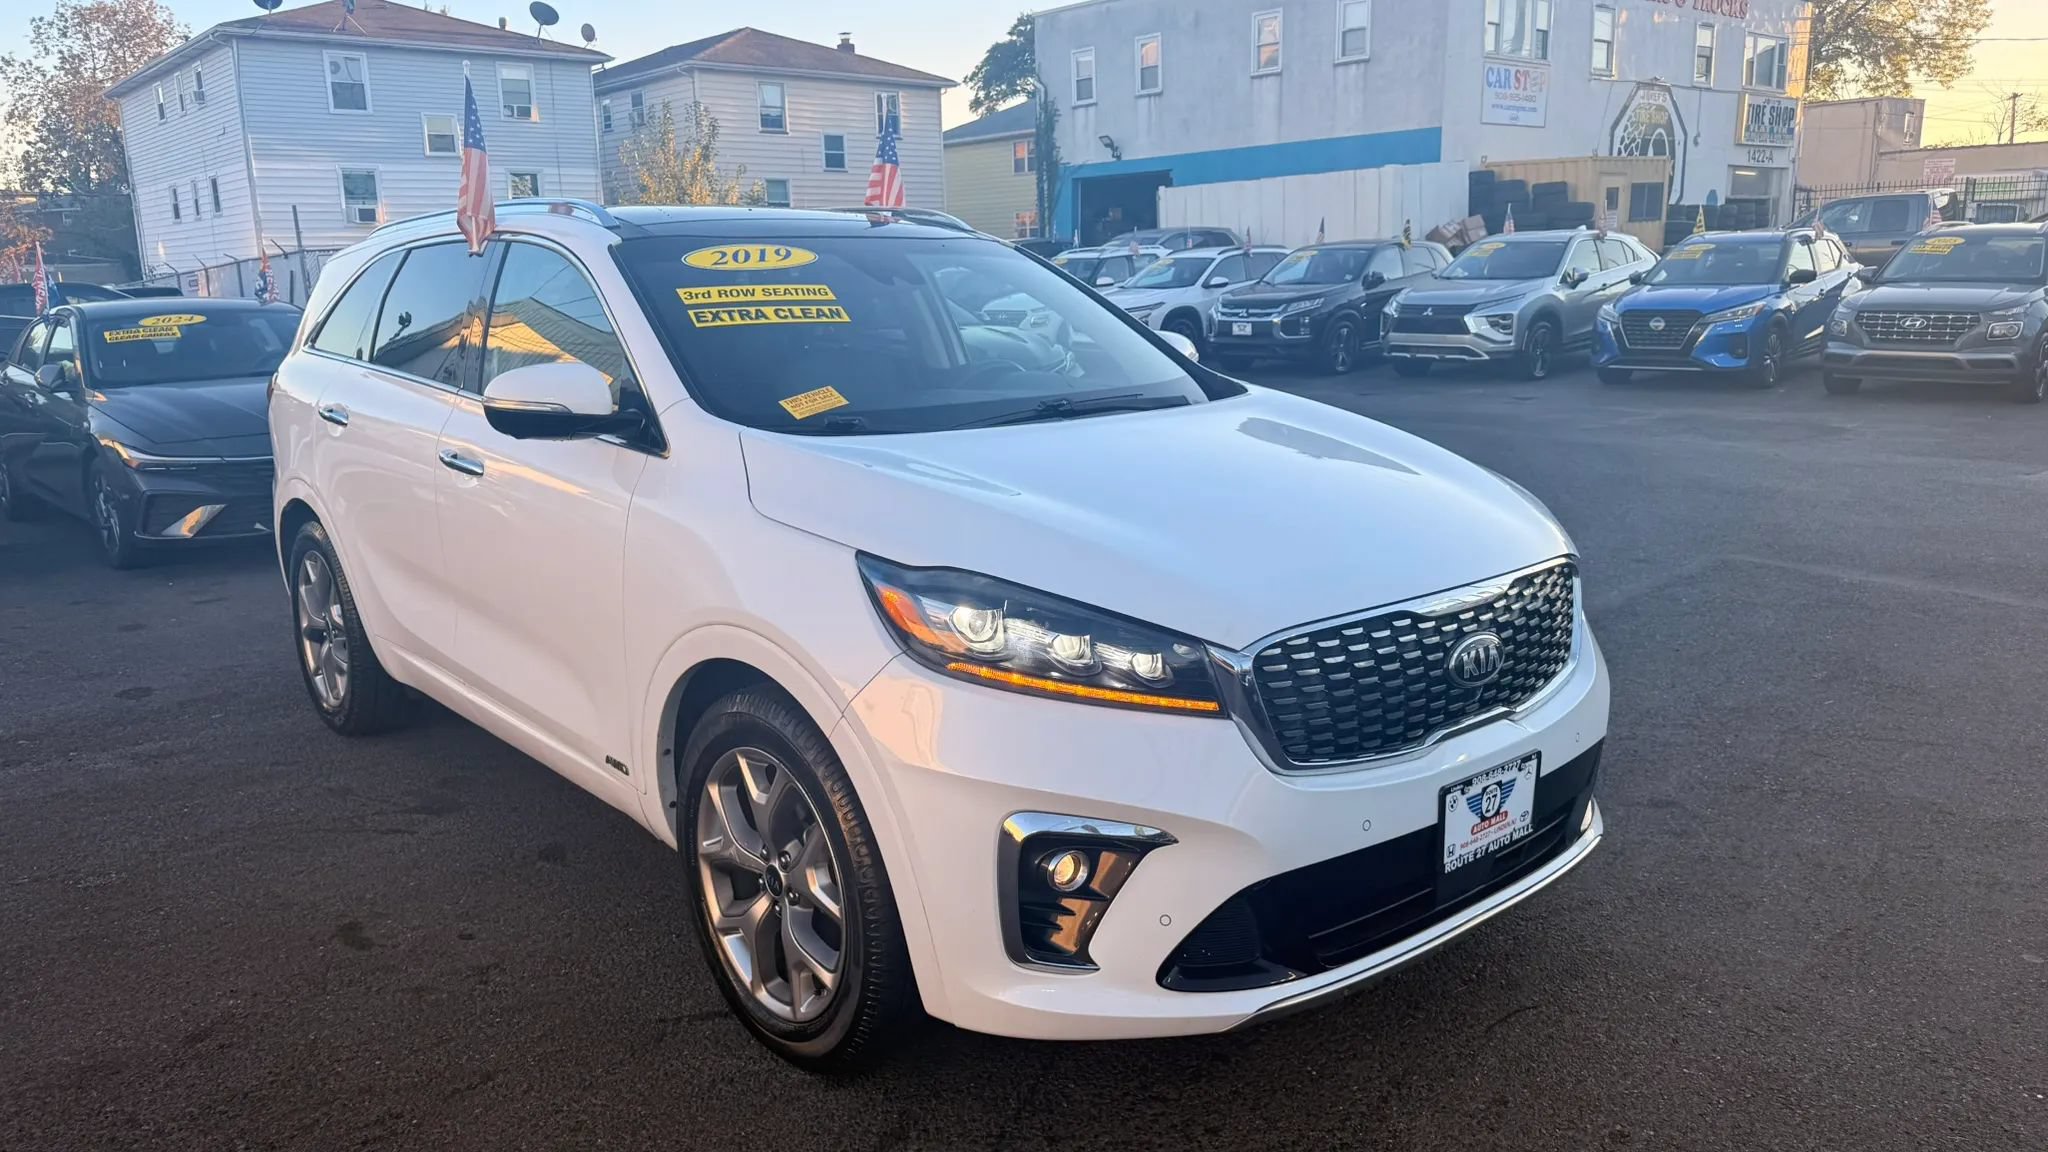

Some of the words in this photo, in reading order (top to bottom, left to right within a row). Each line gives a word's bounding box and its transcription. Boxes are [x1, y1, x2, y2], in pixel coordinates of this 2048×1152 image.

[1486, 66, 1511, 90] CAR
[1747, 103, 1767, 125] TIRE
[1768, 105, 1795, 127] SHOP
[1747, 149, 1774, 163] 1422-A
[711, 247, 793, 267] 2019
[683, 289, 712, 301] 3rd
[718, 288, 756, 299] ROW
[762, 286, 829, 298] SEATING
[693, 309, 769, 324] EXTRA
[773, 307, 842, 321] CLEAN
[1461, 644, 1499, 679] KIA
[1485, 794, 1498, 814] 27
[1473, 820, 1490, 833] AUTO
[1490, 812, 1507, 826] MALL
[1445, 853, 1475, 873] ROUTE
[1476, 847, 1486, 859] 27
[1488, 836, 1511, 853] AUTO
[1512, 824, 1534, 841] MALL
